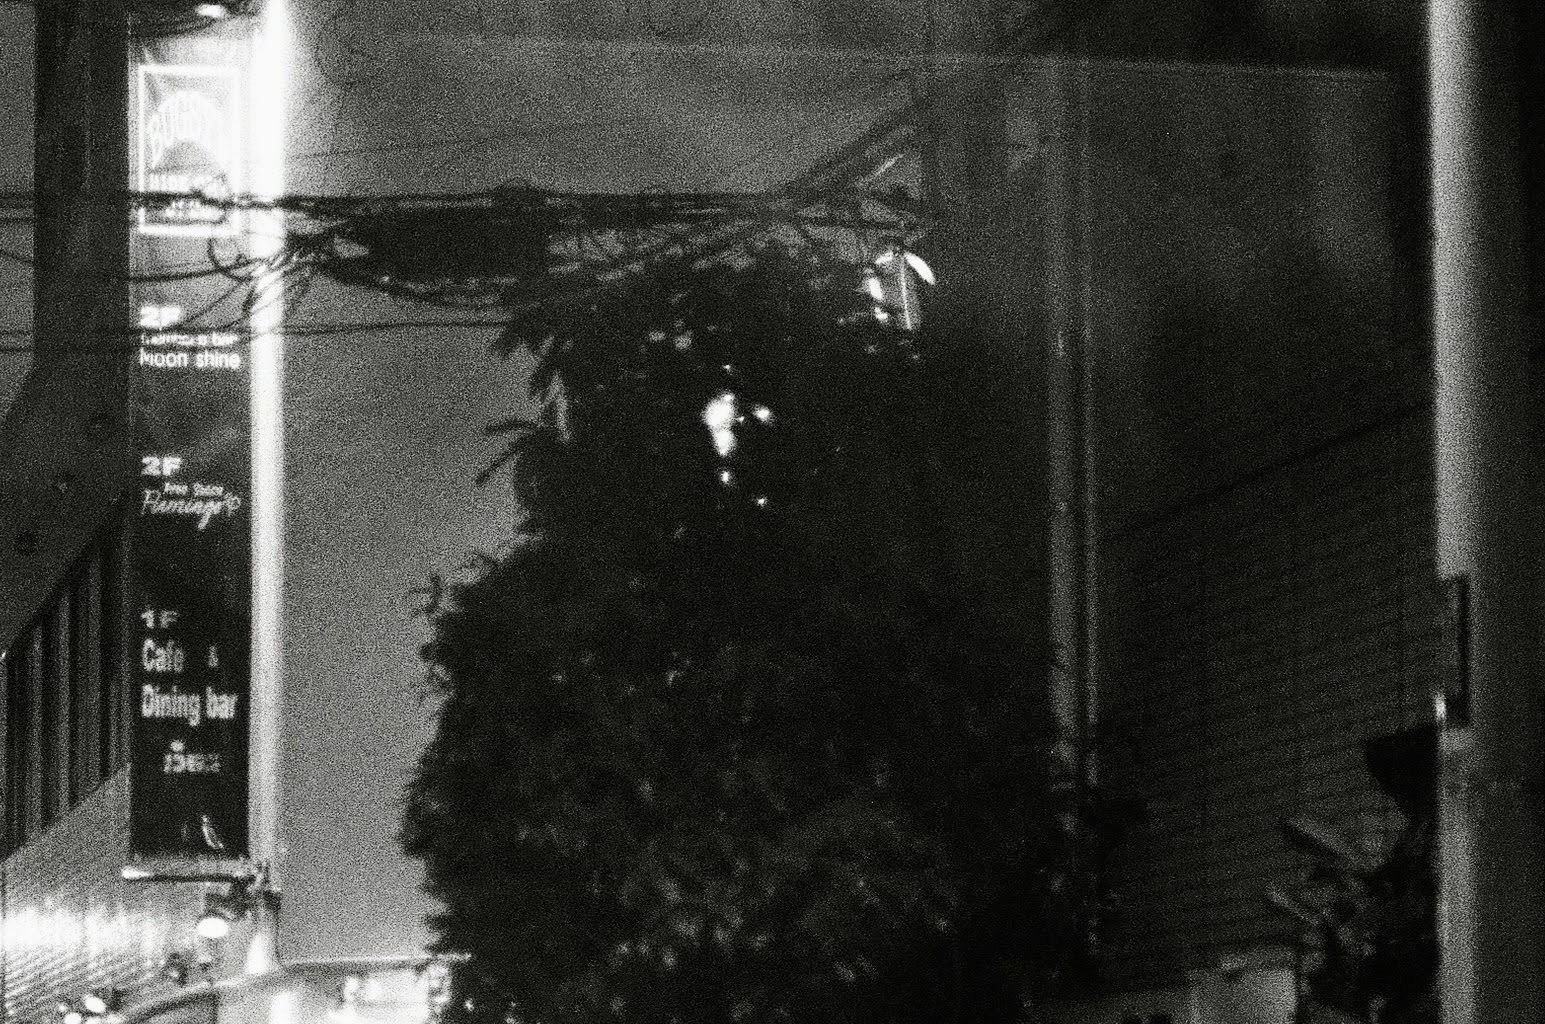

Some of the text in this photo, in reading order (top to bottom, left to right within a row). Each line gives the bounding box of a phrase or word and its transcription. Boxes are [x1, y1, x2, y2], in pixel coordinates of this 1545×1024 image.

[139, 347, 242, 369] Moon shine
[142, 457, 182, 475] 2F
[140, 610, 178, 629] 1F
[142, 639, 184, 672] Cafe
[141, 684, 238, 726] Dining bar
